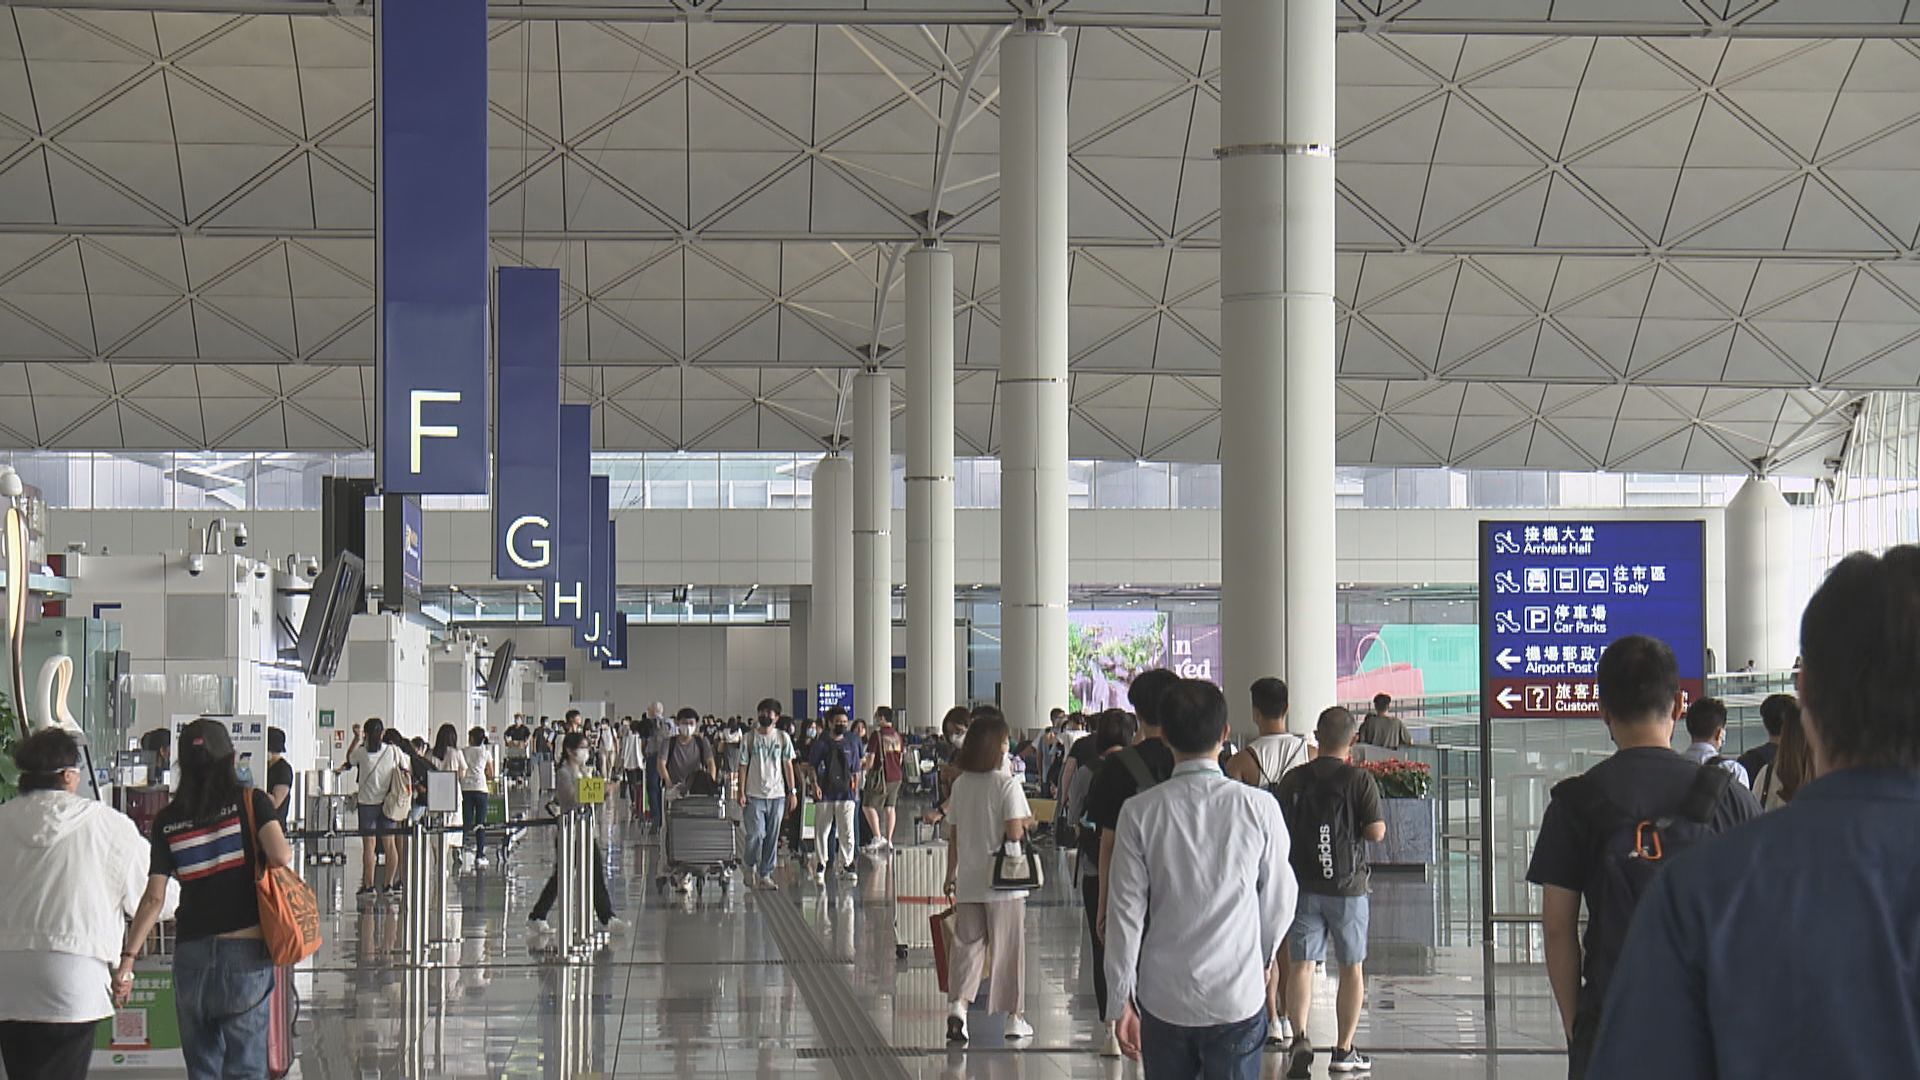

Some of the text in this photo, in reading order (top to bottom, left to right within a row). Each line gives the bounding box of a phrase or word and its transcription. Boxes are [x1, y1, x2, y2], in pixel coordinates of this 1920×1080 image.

[410, 389, 461, 475] F
[505, 515, 551, 569] G
[1524, 526, 1595, 542] 接機大堂
[1524, 542, 1591, 555] Arrivals Hall
[1612, 582, 1649, 596] To city
[554, 581, 582, 619] H
[1554, 604, 1607, 621] 停車場
[584, 611, 600, 642] J
[1554, 621, 1607, 634] Car Parks
[1525, 662, 1566, 676] Airport
[1567, 662, 1592, 674] Post
[583, 781, 601, 792] 入口
[1317, 823, 1334, 880] adidas
